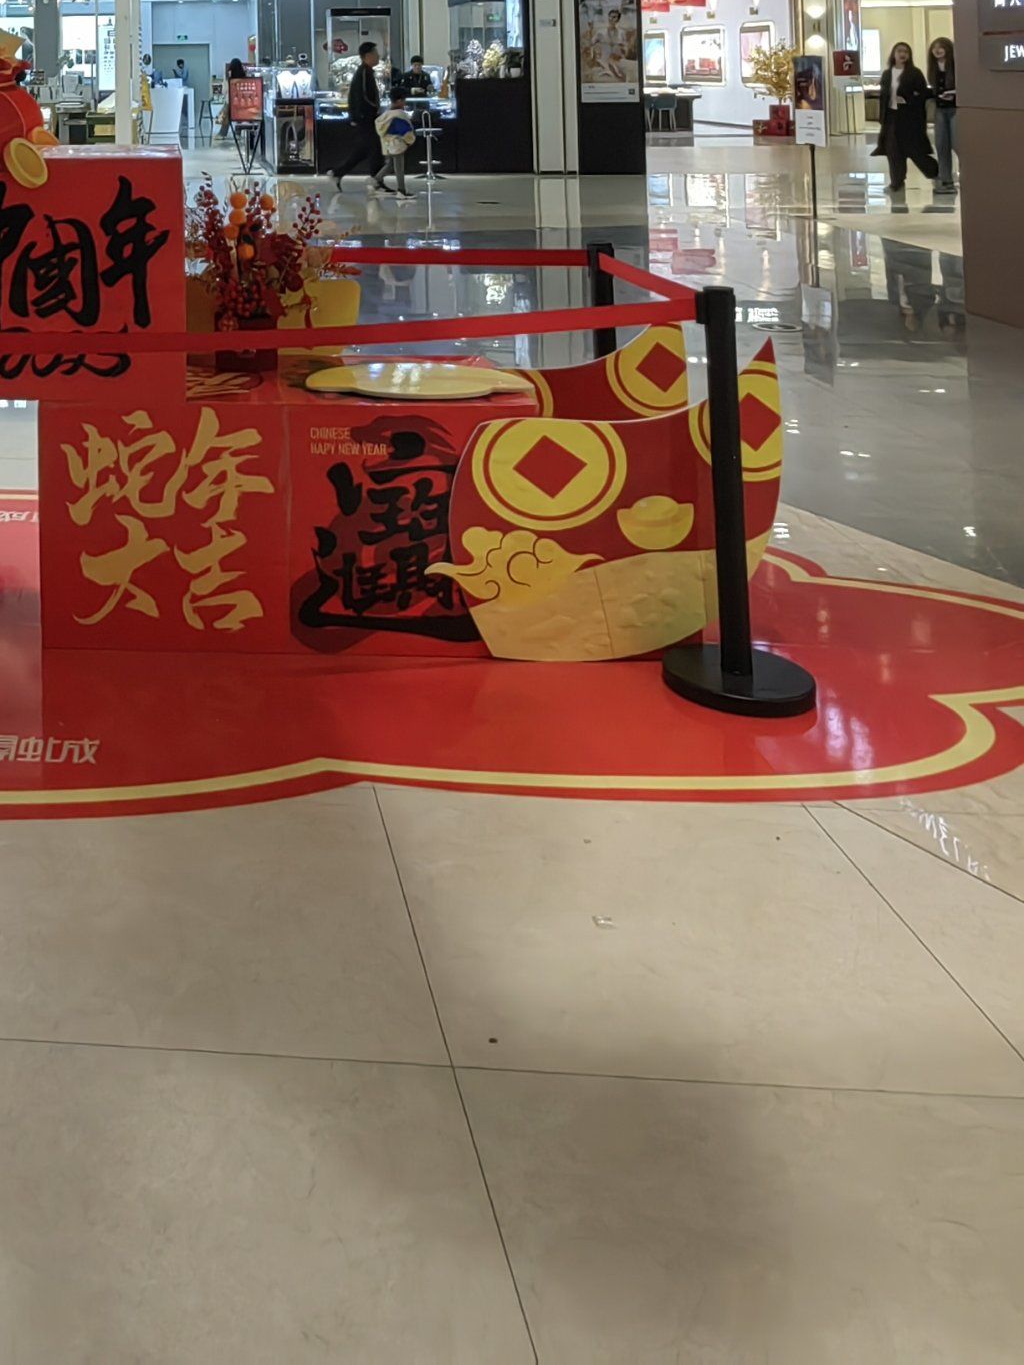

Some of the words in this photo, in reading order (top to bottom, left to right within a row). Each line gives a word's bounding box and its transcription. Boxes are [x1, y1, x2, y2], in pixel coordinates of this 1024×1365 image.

[310, 426, 351, 439] CHINESE
[338, 442, 360, 455] NEW
[361, 442, 387, 455] YEAR
[59, 406, 275, 527] 蛇年
[72, 513, 265, 632] 大吉
